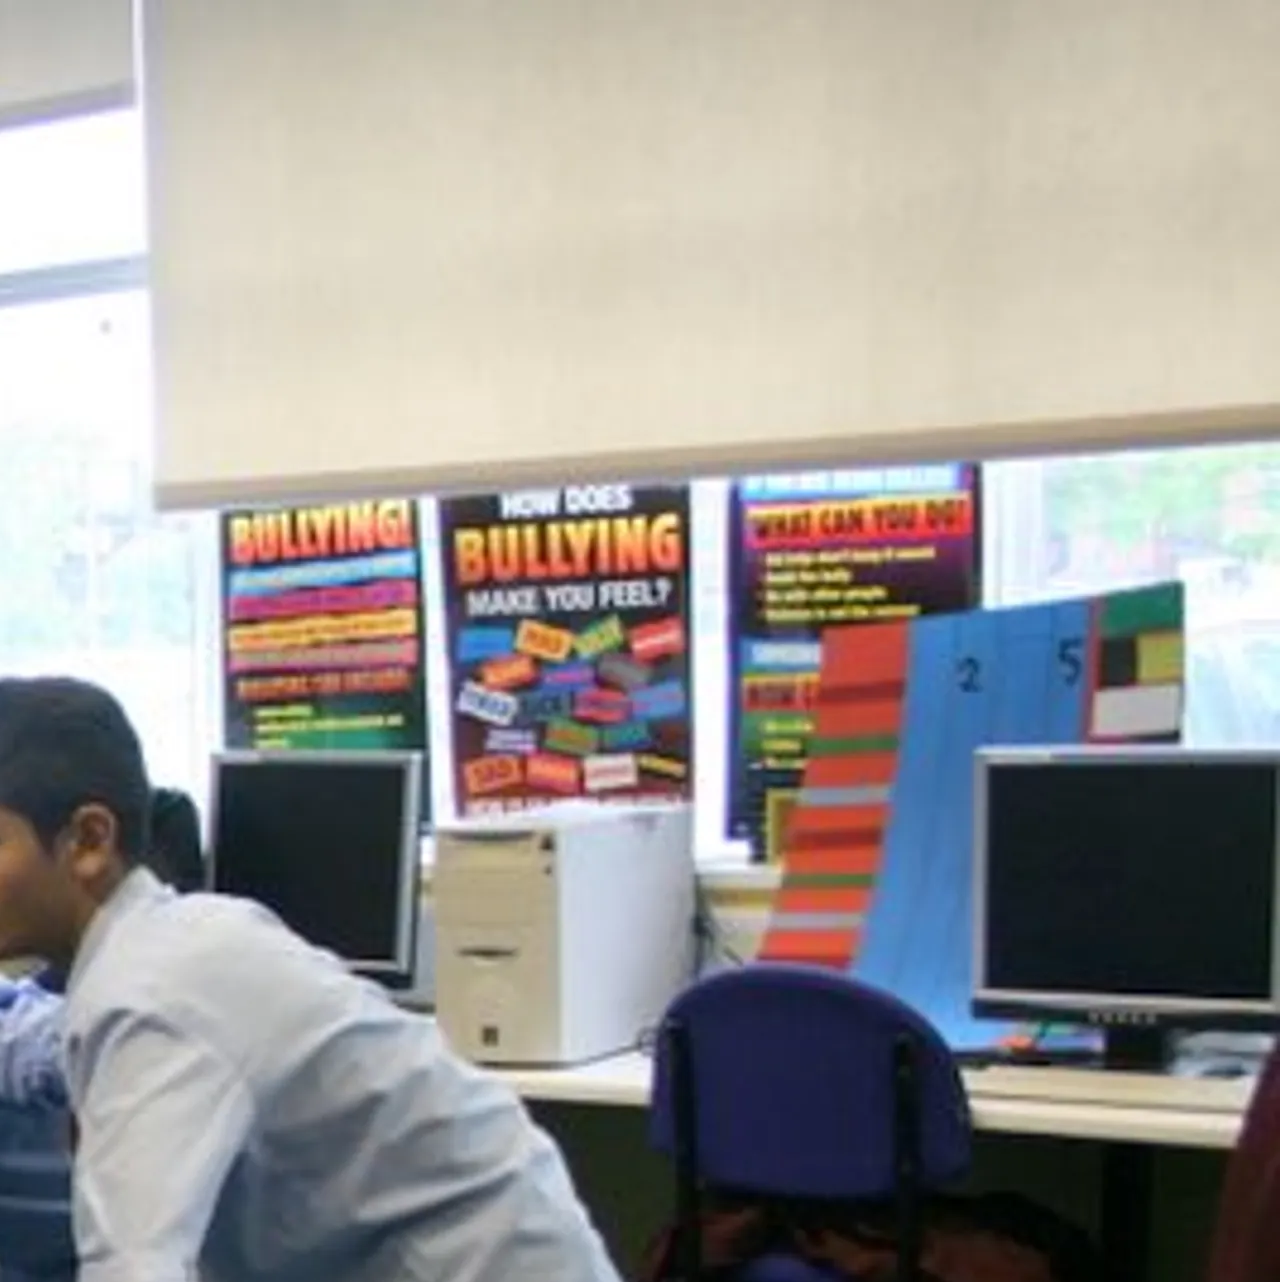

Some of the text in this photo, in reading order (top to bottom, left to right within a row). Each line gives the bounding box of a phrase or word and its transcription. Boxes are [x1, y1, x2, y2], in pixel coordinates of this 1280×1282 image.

[500, 486, 633, 518] HOW DOES
[819, 506, 864, 535] CAN
[872, 502, 917, 532] YOU
[454, 512, 682, 583] BULLYING
[466, 577, 673, 617] MAKE YOU FEEL?
[957, 637, 1084, 693] 2 5
